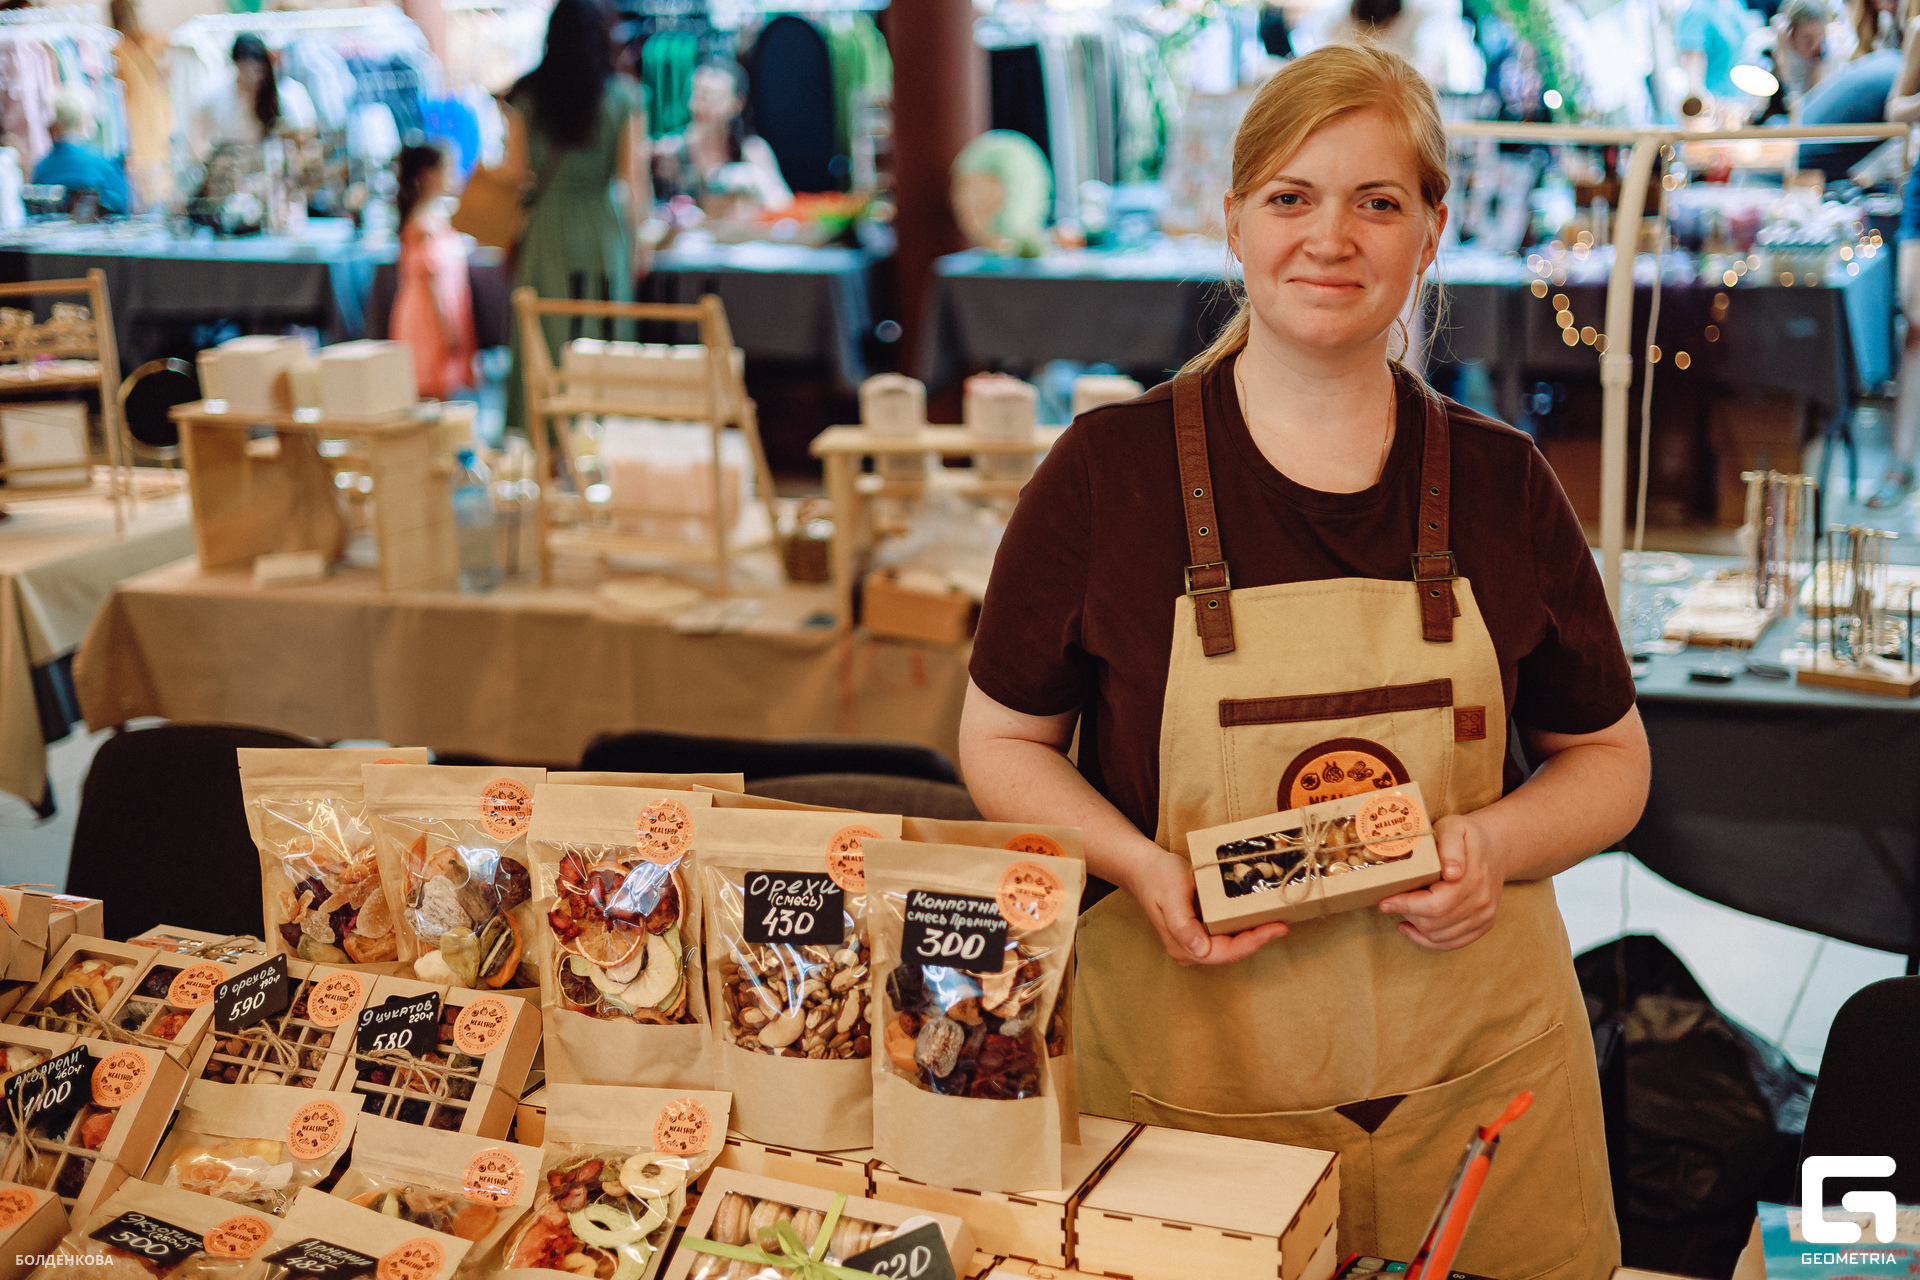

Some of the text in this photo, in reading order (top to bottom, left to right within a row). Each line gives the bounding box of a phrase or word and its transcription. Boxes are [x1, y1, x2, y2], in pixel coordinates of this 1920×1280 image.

[650, 826, 678, 835] MEALSHOP
[1374, 815, 1407, 830] MEALSHOP
[750, 874, 840, 901] Орехи
[771, 892, 824, 911] (смесь)
[762, 906, 814, 937] 430
[907, 910, 947, 926] смесь
[916, 927, 986, 960] 300
[228, 991, 266, 1021] 590
[324, 993, 349, 1003] MEALSHOP
[470, 1019, 497, 1029] MEALSHOP
[372, 1028, 413, 1052] 580
[107, 1071, 134, 1082] MEALSHOP
[23, 1080, 72, 1117] 1100
[301, 1124, 329, 1133] MEALSHOP
[668, 1125, 697, 1135] MEALSHOP
[479, 1175, 508, 1186] MEALSHOP
[121, 1213, 204, 1249] Экзотика
[110, 1231, 170, 1255] 500
[286, 1256, 338, 1272] 485
